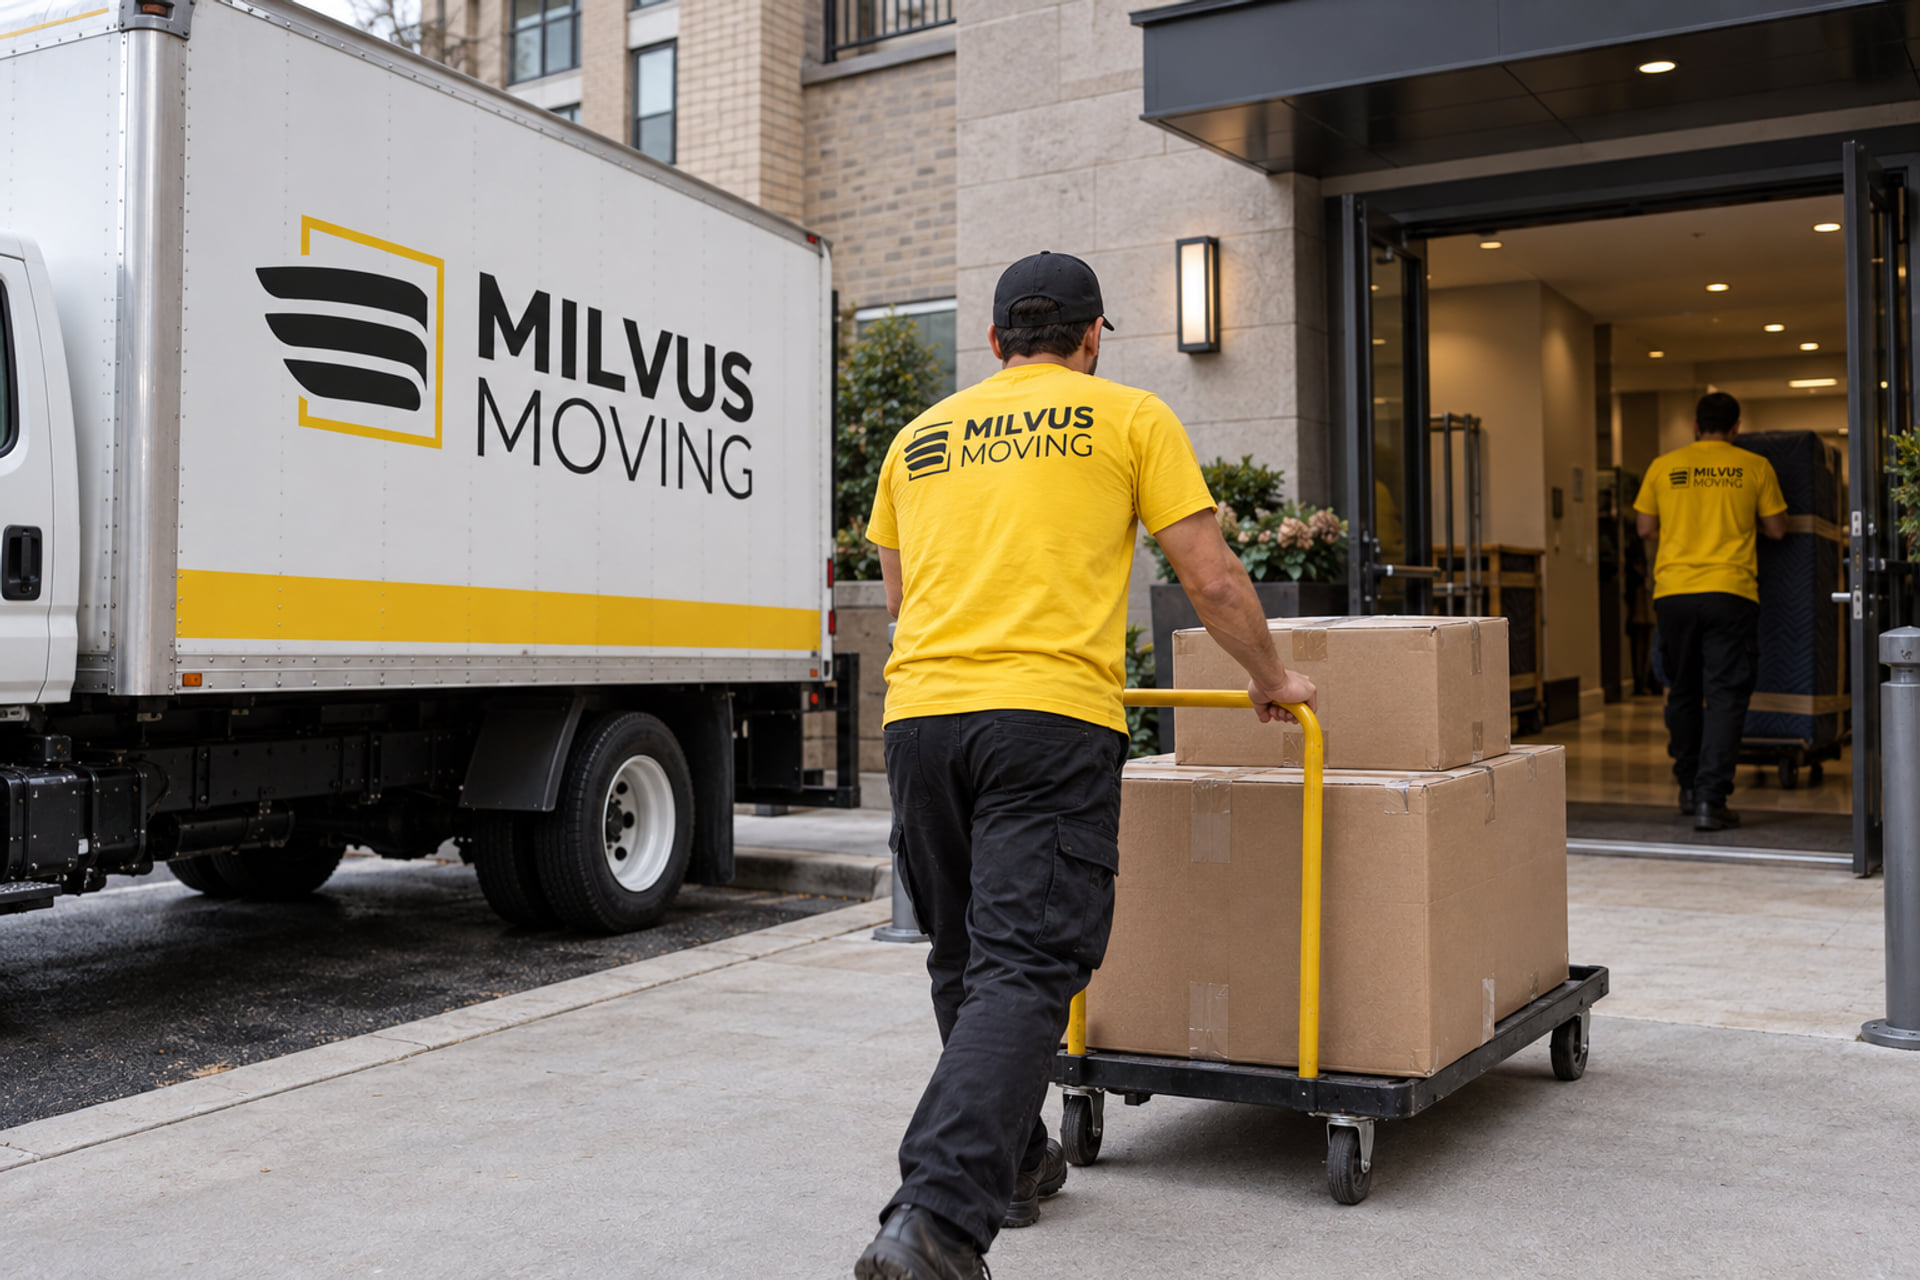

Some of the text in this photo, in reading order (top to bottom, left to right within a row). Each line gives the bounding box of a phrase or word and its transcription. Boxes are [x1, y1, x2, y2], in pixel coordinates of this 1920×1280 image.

[478, 271, 754, 423] MILVUS
[477, 376, 753, 500] MOVING
[964, 406, 1094, 441] MILVUS
[961, 433, 1093, 468] MOVING
[1693, 478, 1743, 488] MOVING
[1694, 467, 1743, 478] MILVUS
